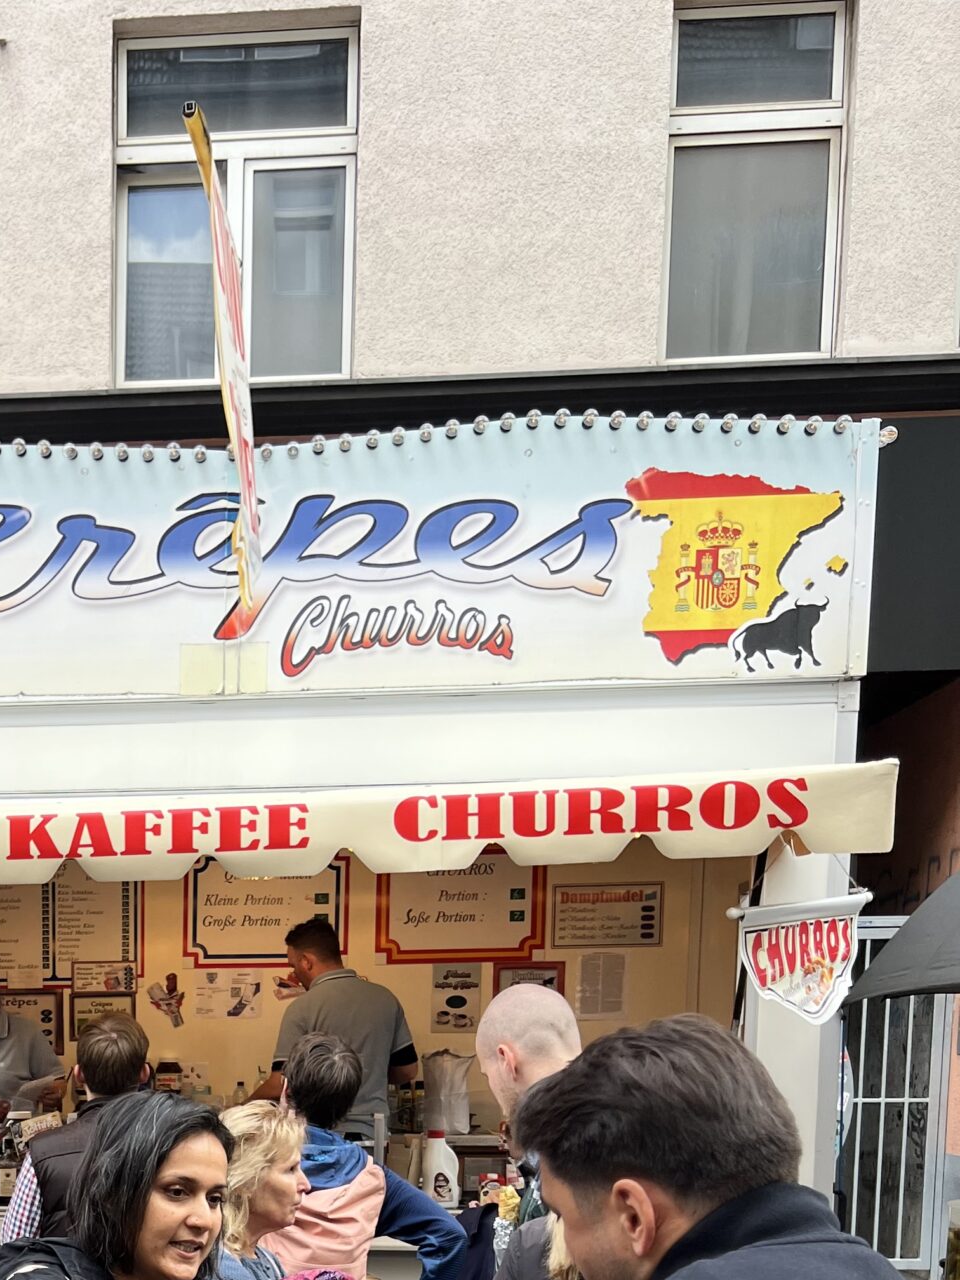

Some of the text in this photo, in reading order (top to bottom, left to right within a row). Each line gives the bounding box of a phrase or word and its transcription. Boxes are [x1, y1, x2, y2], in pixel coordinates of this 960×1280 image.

[281, 594, 514, 678] Churros
[6, 803, 310, 860] KAFFEE
[393, 778, 809, 842] CHURROS
[204, 894, 239, 906] Kleine
[243, 894, 284, 906] Portion
[438, 889, 479, 902] Portion
[560, 889, 644, 905] Dampfnudel
[202, 915, 236, 931] Große
[241, 914, 281, 926] Portion
[435, 911, 476, 924] Portion
[751, 917, 851, 988] CHURROS
[1, 998, 38, 1008] rêpes
